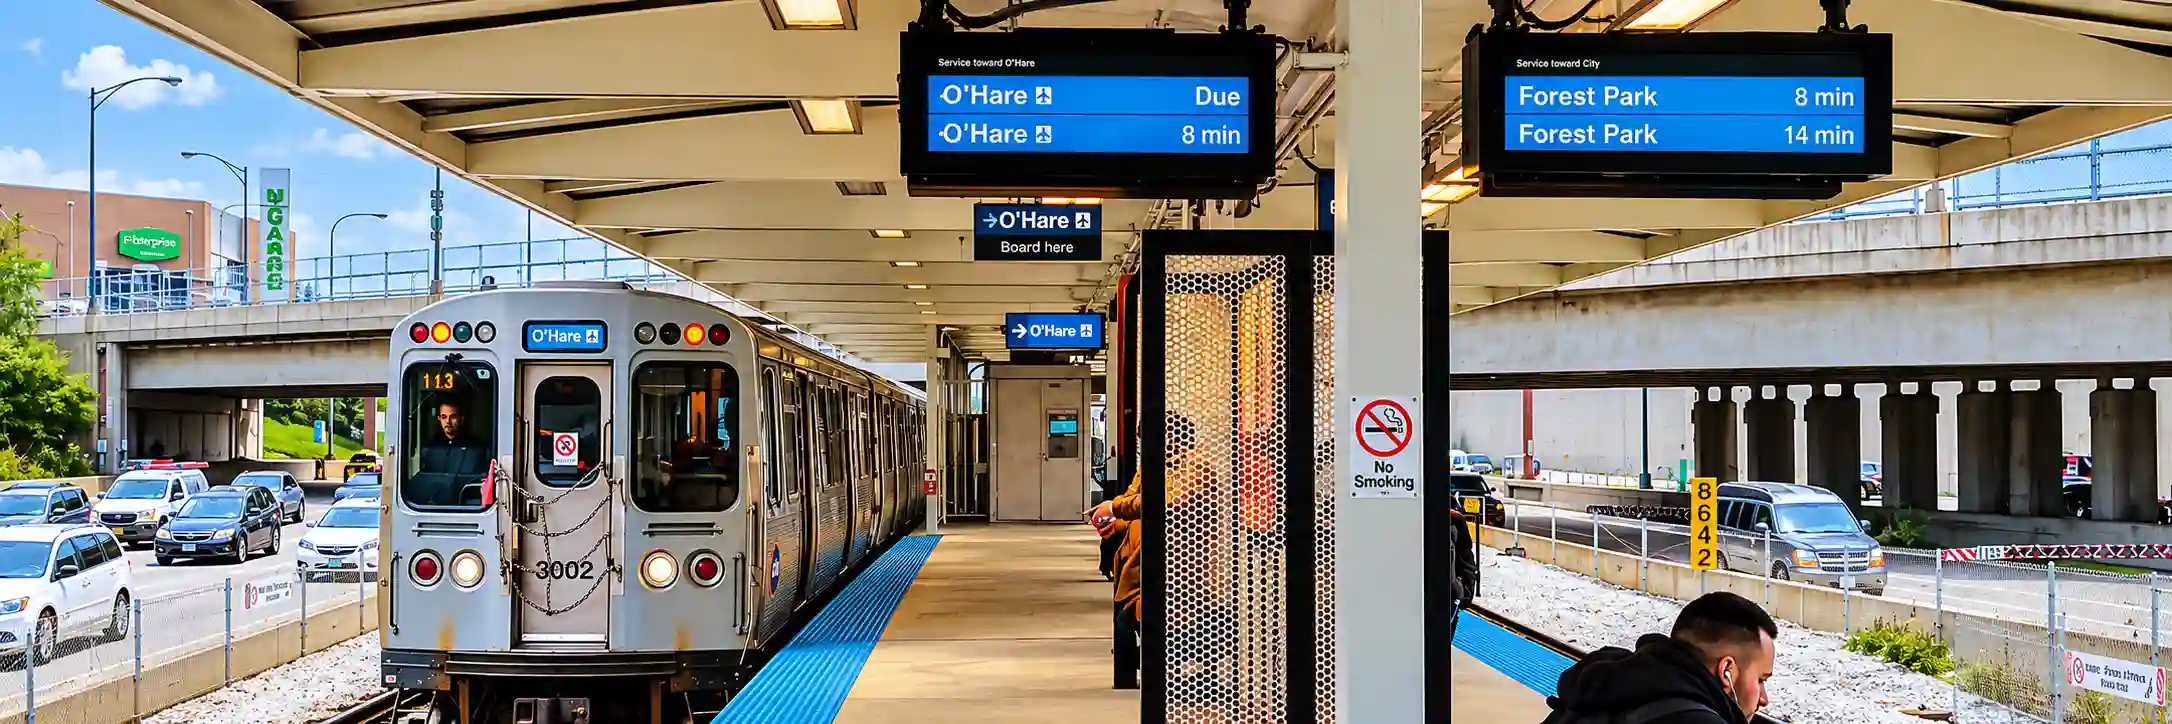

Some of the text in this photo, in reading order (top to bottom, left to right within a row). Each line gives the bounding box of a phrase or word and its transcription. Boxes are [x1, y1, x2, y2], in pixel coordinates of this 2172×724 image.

[938, 58, 1036, 68] Service toward O'Hare
[1516, 59, 1601, 70] Service toward City
[943, 84, 1241, 107] O'Hare Due
[1519, 85, 1854, 107] Forest Park 8 min
[943, 122, 1241, 145] O'Hare 8 min
[1519, 123, 1854, 145] Forest Park 14 min
[999, 211, 1070, 229] O'Hare
[1000, 241, 1074, 253] Board here
[532, 329, 582, 343] O'Hare
[1030, 324, 1077, 337] O'Hare
[1374, 460, 1394, 473] No
[1354, 474, 1414, 491] Smoking
[535, 560, 594, 580] 3002
